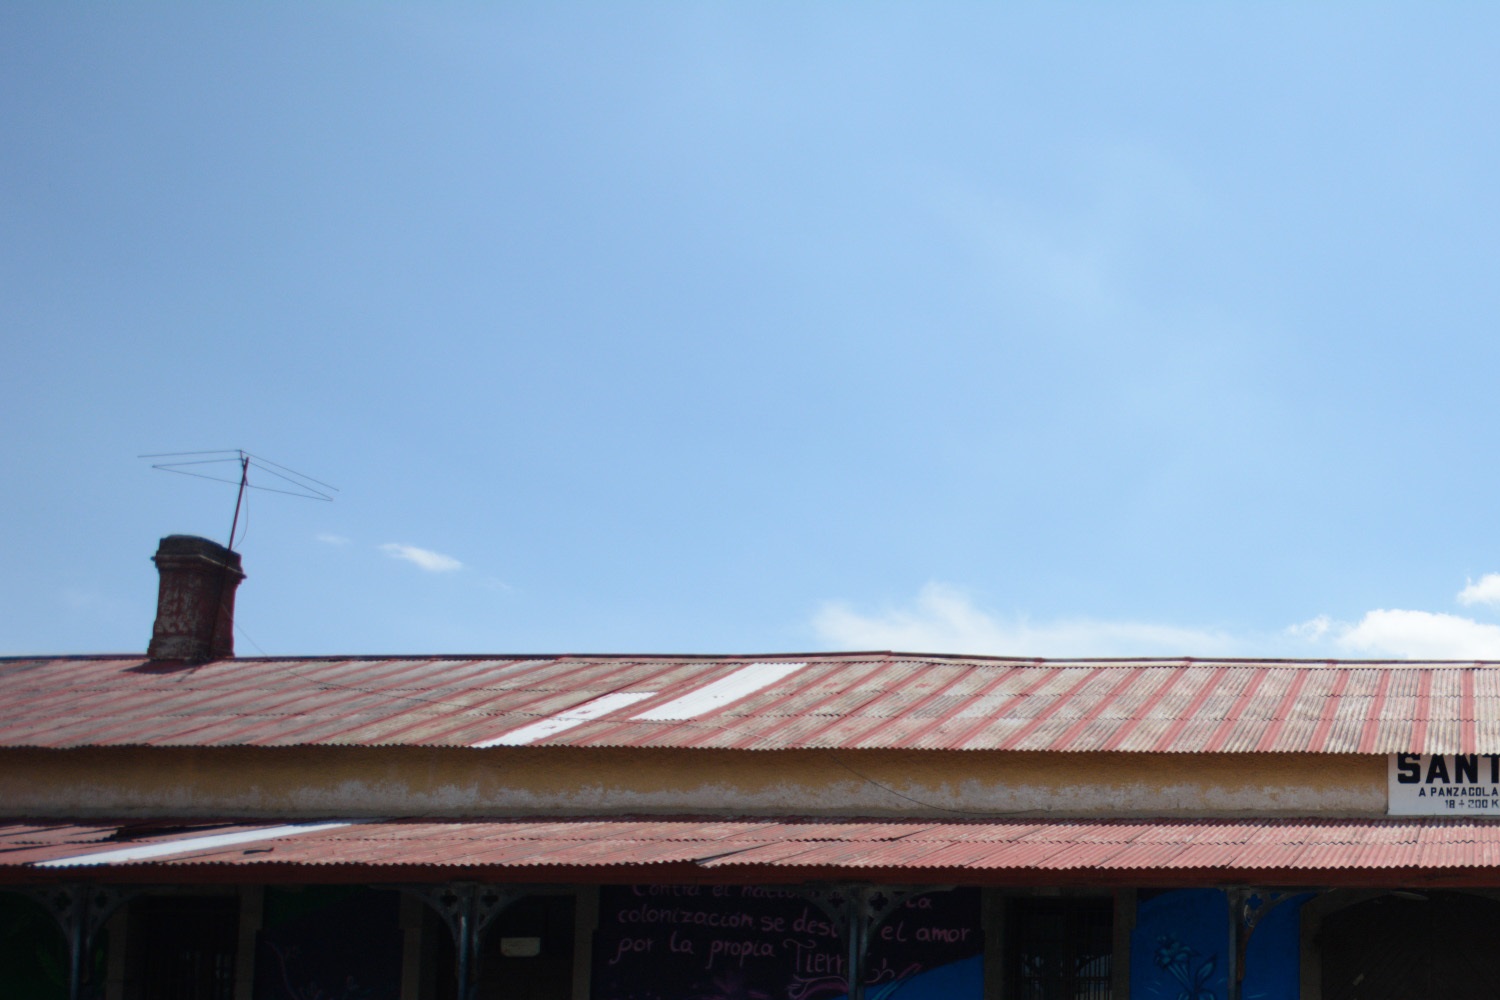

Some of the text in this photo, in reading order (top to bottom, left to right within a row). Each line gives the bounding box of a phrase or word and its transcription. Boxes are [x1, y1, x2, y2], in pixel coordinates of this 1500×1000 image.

[1418, 787, 1426, 797] A
[1430, 787, 1498, 797] PANZACOLA
[1445, 799, 1455, 809] 18
[760, 915, 785, 933] se
[881, 921, 971, 943] el amor
[608, 937, 655, 965] por
[704, 939, 776, 970] propia
